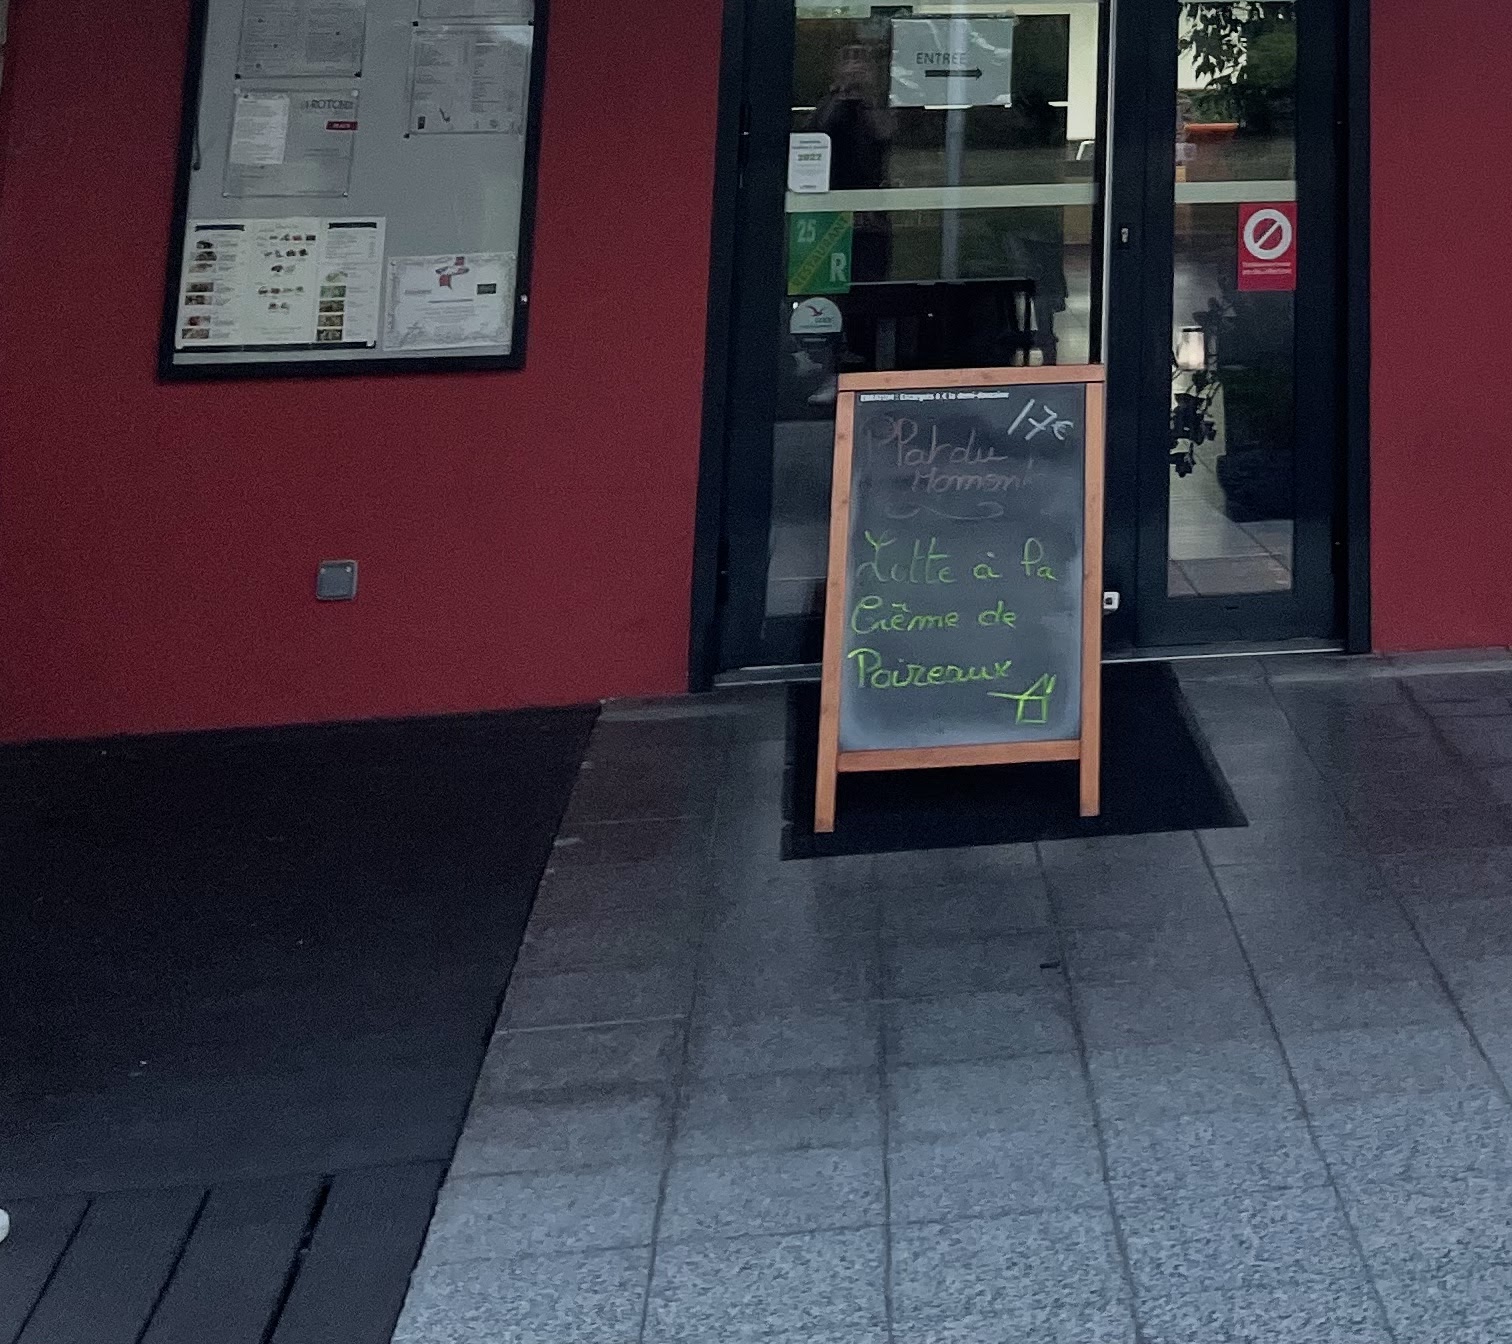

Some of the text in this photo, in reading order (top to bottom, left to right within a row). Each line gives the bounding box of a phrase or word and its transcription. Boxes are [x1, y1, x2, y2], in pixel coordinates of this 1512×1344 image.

[797, 218, 817, 243] 25
[829, 252, 848, 283] R
[978, 600, 1016, 629] de
